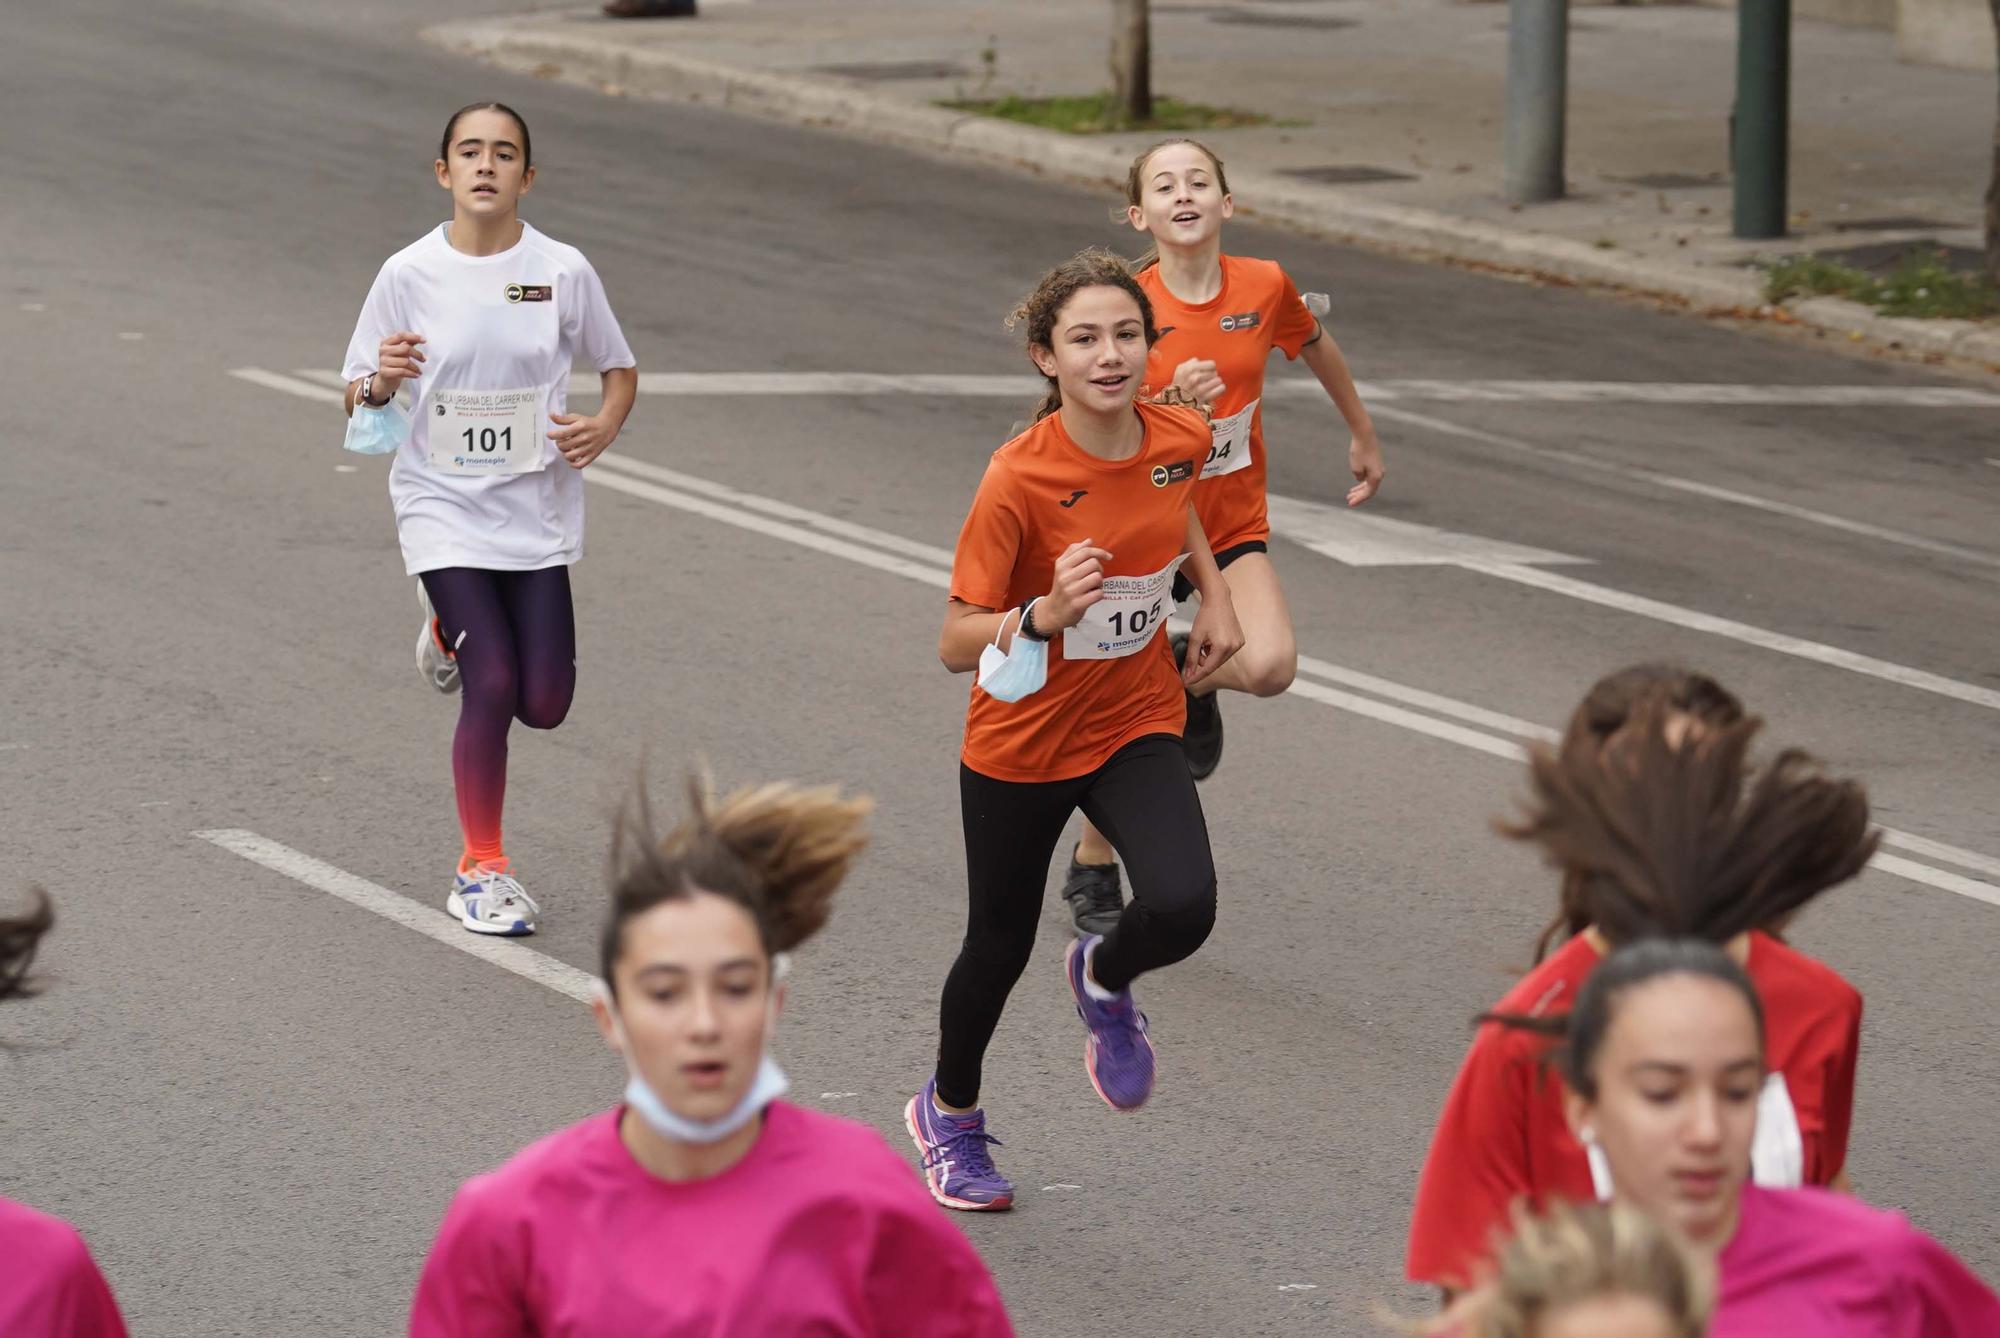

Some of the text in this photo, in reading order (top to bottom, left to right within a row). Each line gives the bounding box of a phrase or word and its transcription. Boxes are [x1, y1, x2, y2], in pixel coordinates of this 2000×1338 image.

[480, 396, 493, 406] DEL
[495, 394, 521, 406] CARRER
[522, 392, 535, 402] NOU
[462, 426, 511, 452] 101
[466, 456, 506, 465] montepio
[1103, 581, 1130, 591] RBANA
[1131, 581, 1147, 591] DEL
[1108, 598, 1162, 636] 105
